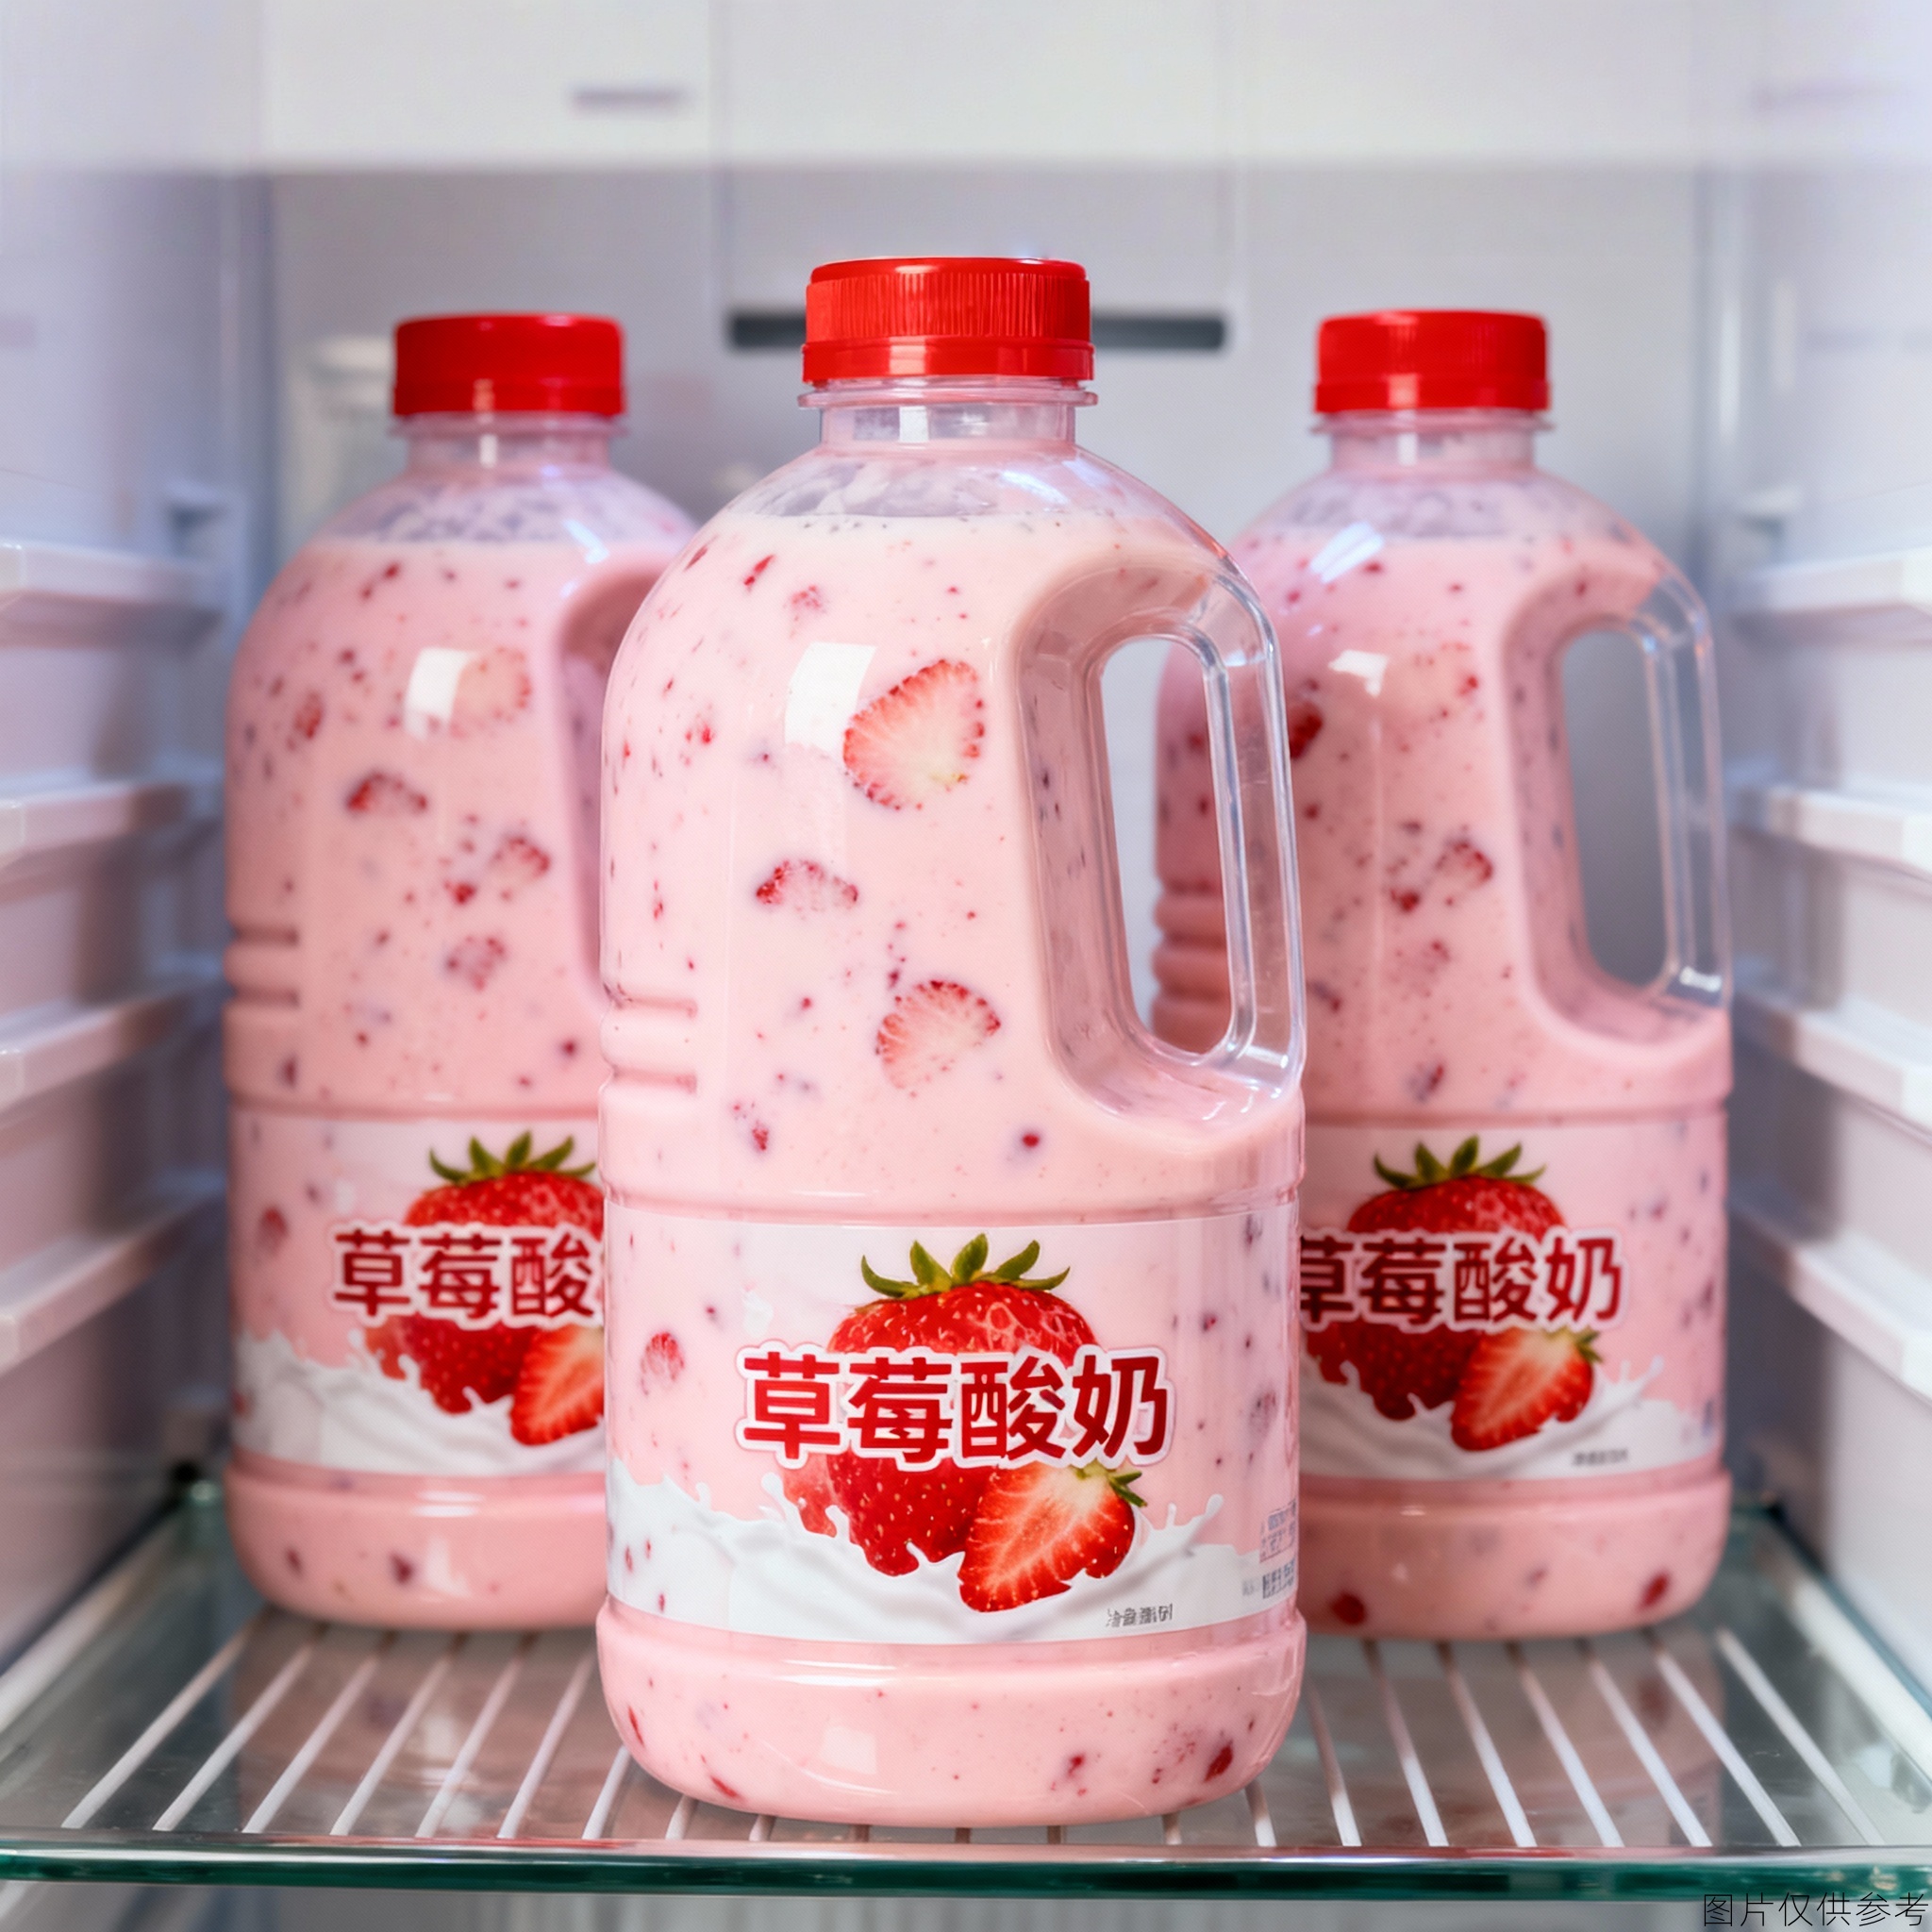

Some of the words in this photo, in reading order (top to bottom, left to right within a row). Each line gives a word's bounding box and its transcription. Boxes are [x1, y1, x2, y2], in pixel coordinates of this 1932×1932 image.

[1300, 1237, 1621, 1324] 草莓酸奶
[743, 1351, 1168, 1462] 草莓酸奶
